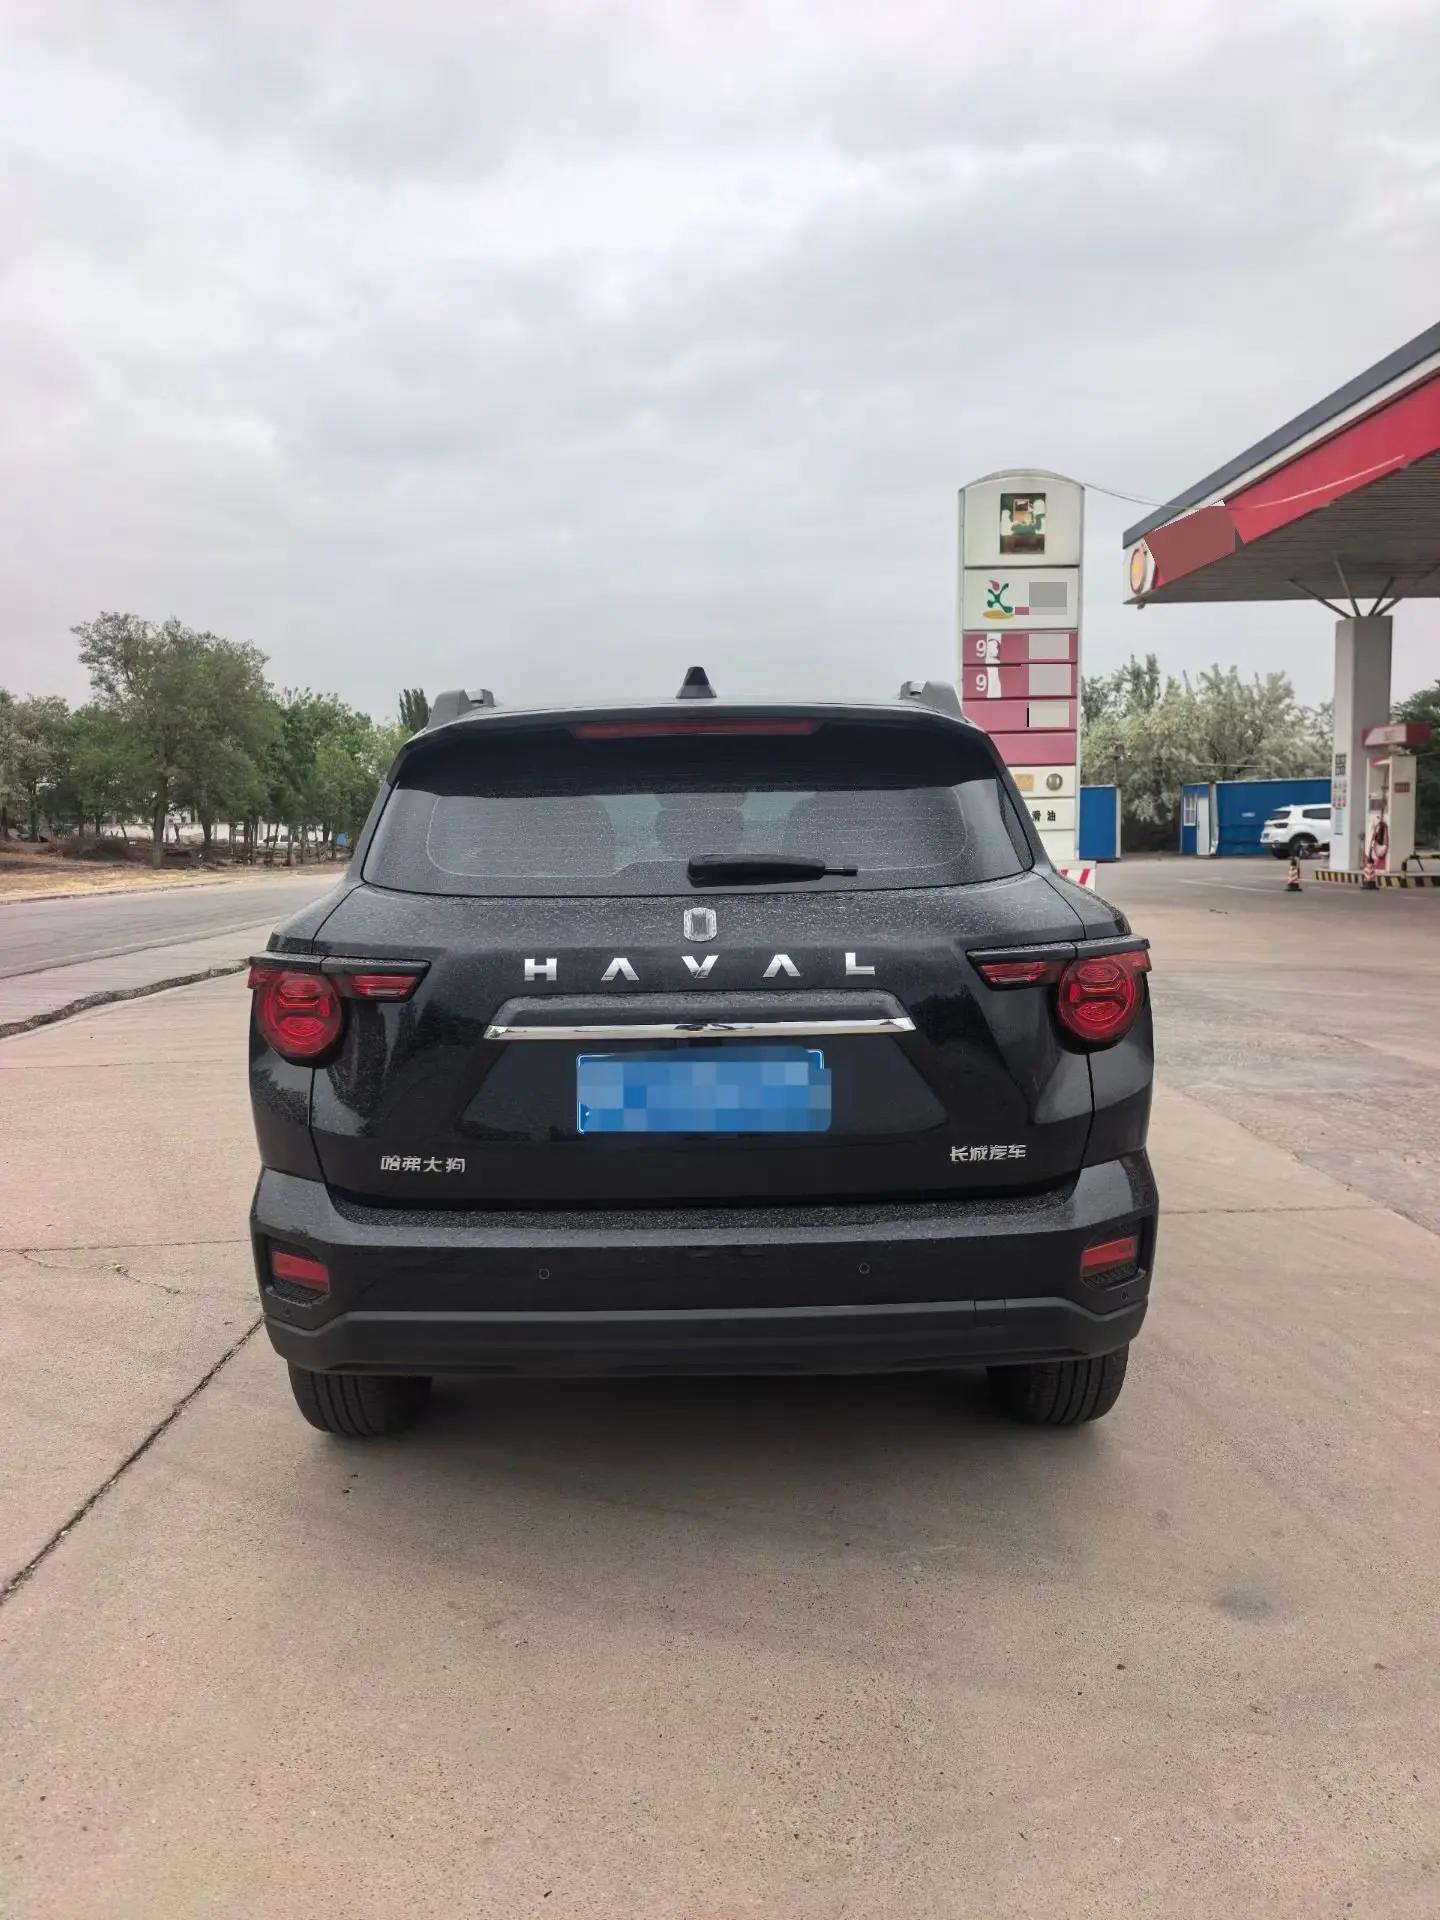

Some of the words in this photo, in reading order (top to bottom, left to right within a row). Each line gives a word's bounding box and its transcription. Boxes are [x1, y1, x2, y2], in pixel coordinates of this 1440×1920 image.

[524, 952, 875, 981] HAVAL
[950, 1144, 1027, 1162] 长城汽车
[380, 1154, 466, 1173] 哈弗大狗
